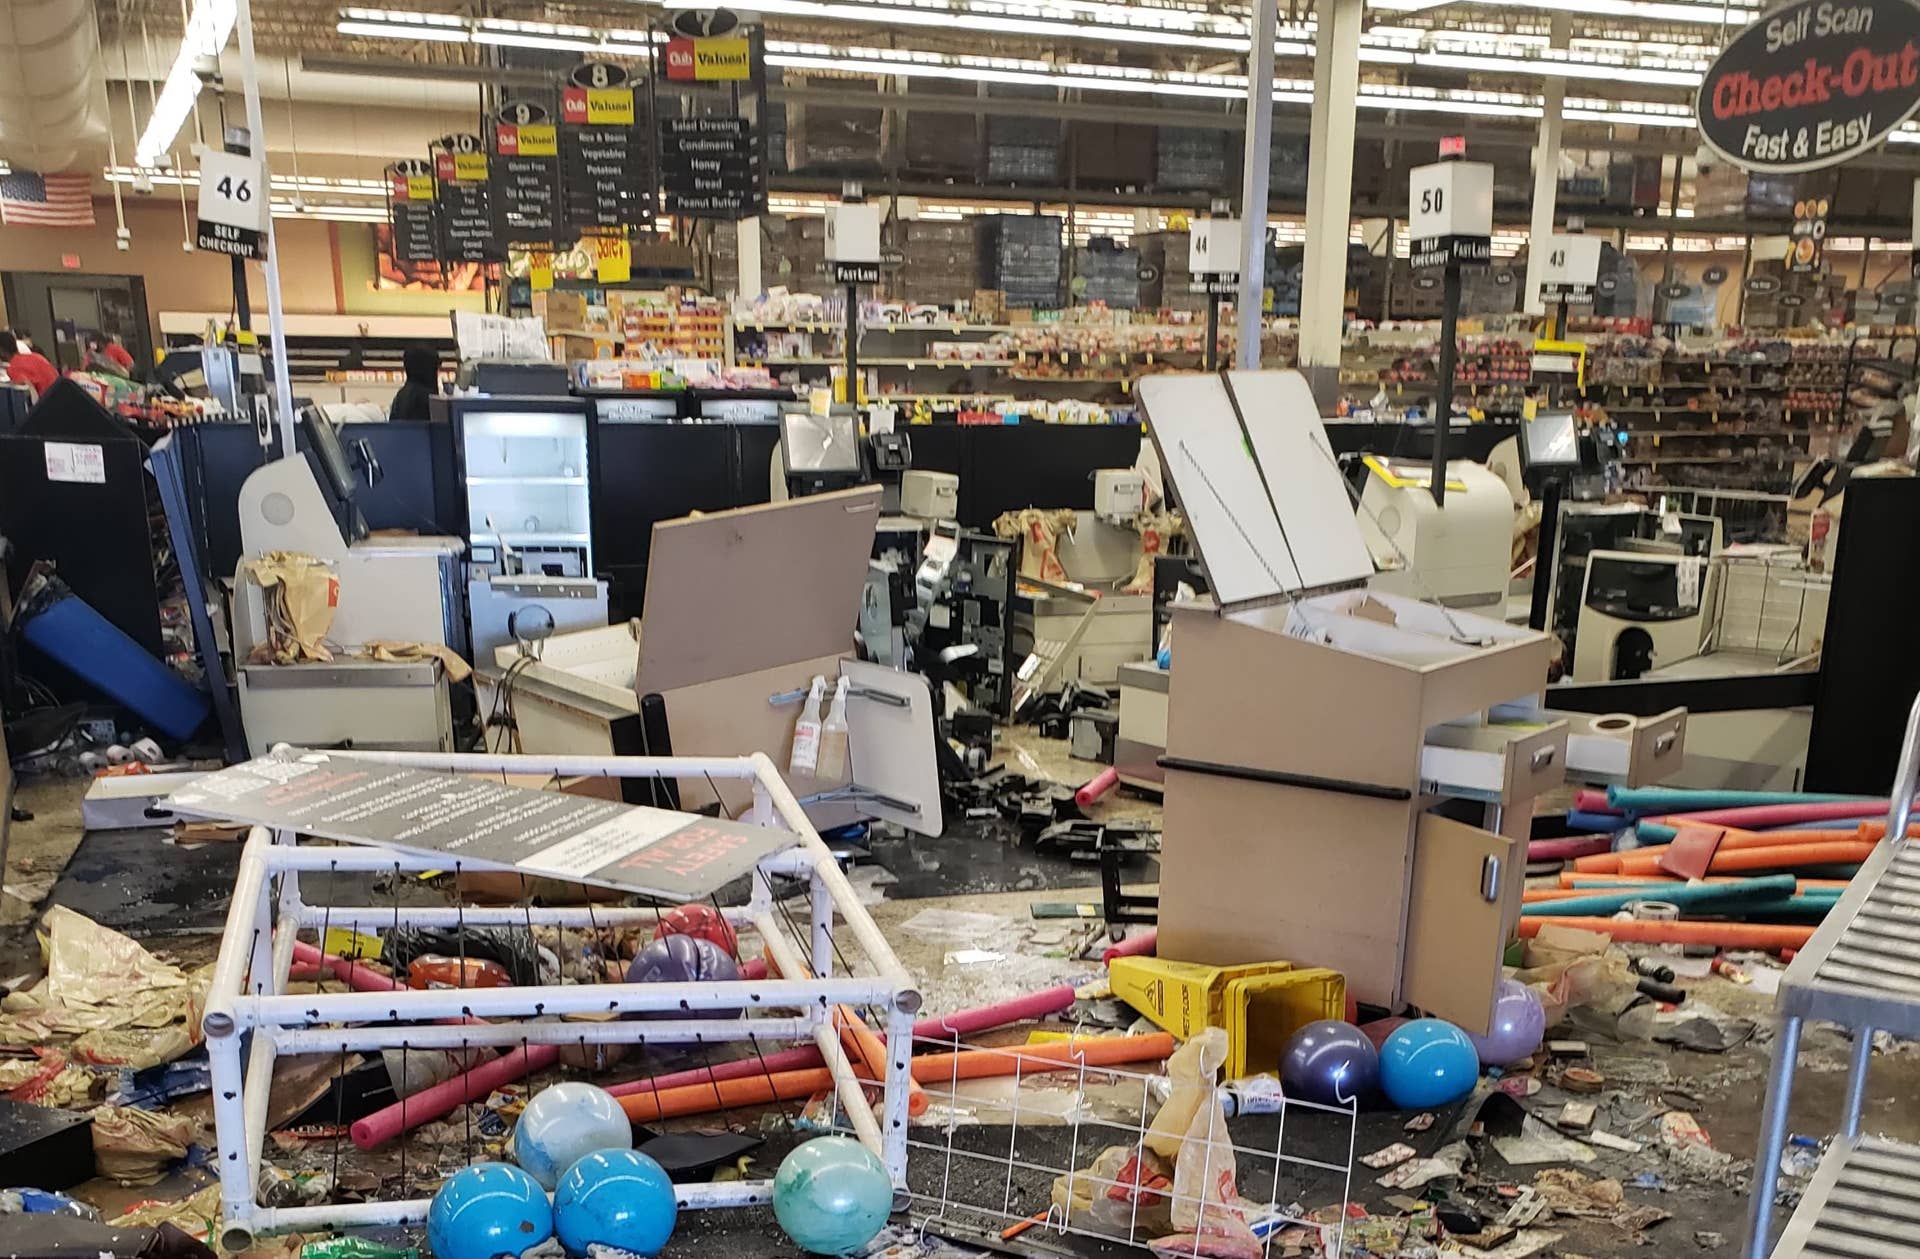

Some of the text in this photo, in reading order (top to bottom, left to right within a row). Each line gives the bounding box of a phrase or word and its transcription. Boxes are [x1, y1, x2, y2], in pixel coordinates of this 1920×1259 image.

[696, 10, 715, 36] 7
[1766, 3, 1873, 53] Self Scan
[669, 51, 746, 66] Cub Values!
[592, 64, 608, 88] 8
[1713, 40, 1920, 119] Check-Out
[516, 104, 530, 125] 9
[590, 100, 631, 112] Values!
[672, 120, 740, 134] Salad Dressing
[1742, 112, 1872, 160] Fast & Easy
[452, 134, 474, 153] 10
[679, 139, 734, 152] Condiments
[582, 148, 626, 160] Vegetables
[405, 160, 422, 177] 11
[587, 165, 622, 176] Potatoes
[691, 158, 720, 173] Honey
[217, 176, 251, 202] 46
[695, 178, 722, 190] Bread
[677, 196, 740, 208] Peanut Butter
[1421, 188, 1443, 213] 50
[214, 223, 240, 240] SELF
[199, 236, 254, 257] CHECKOUT
[1196, 235, 1207, 253] 44
[1421, 237, 1439, 252] SELF
[1410, 249, 1449, 269] CHECKOUT
[618, 827, 720, 869] FOR ALL
[664, 834, 748, 876] SAFETY
